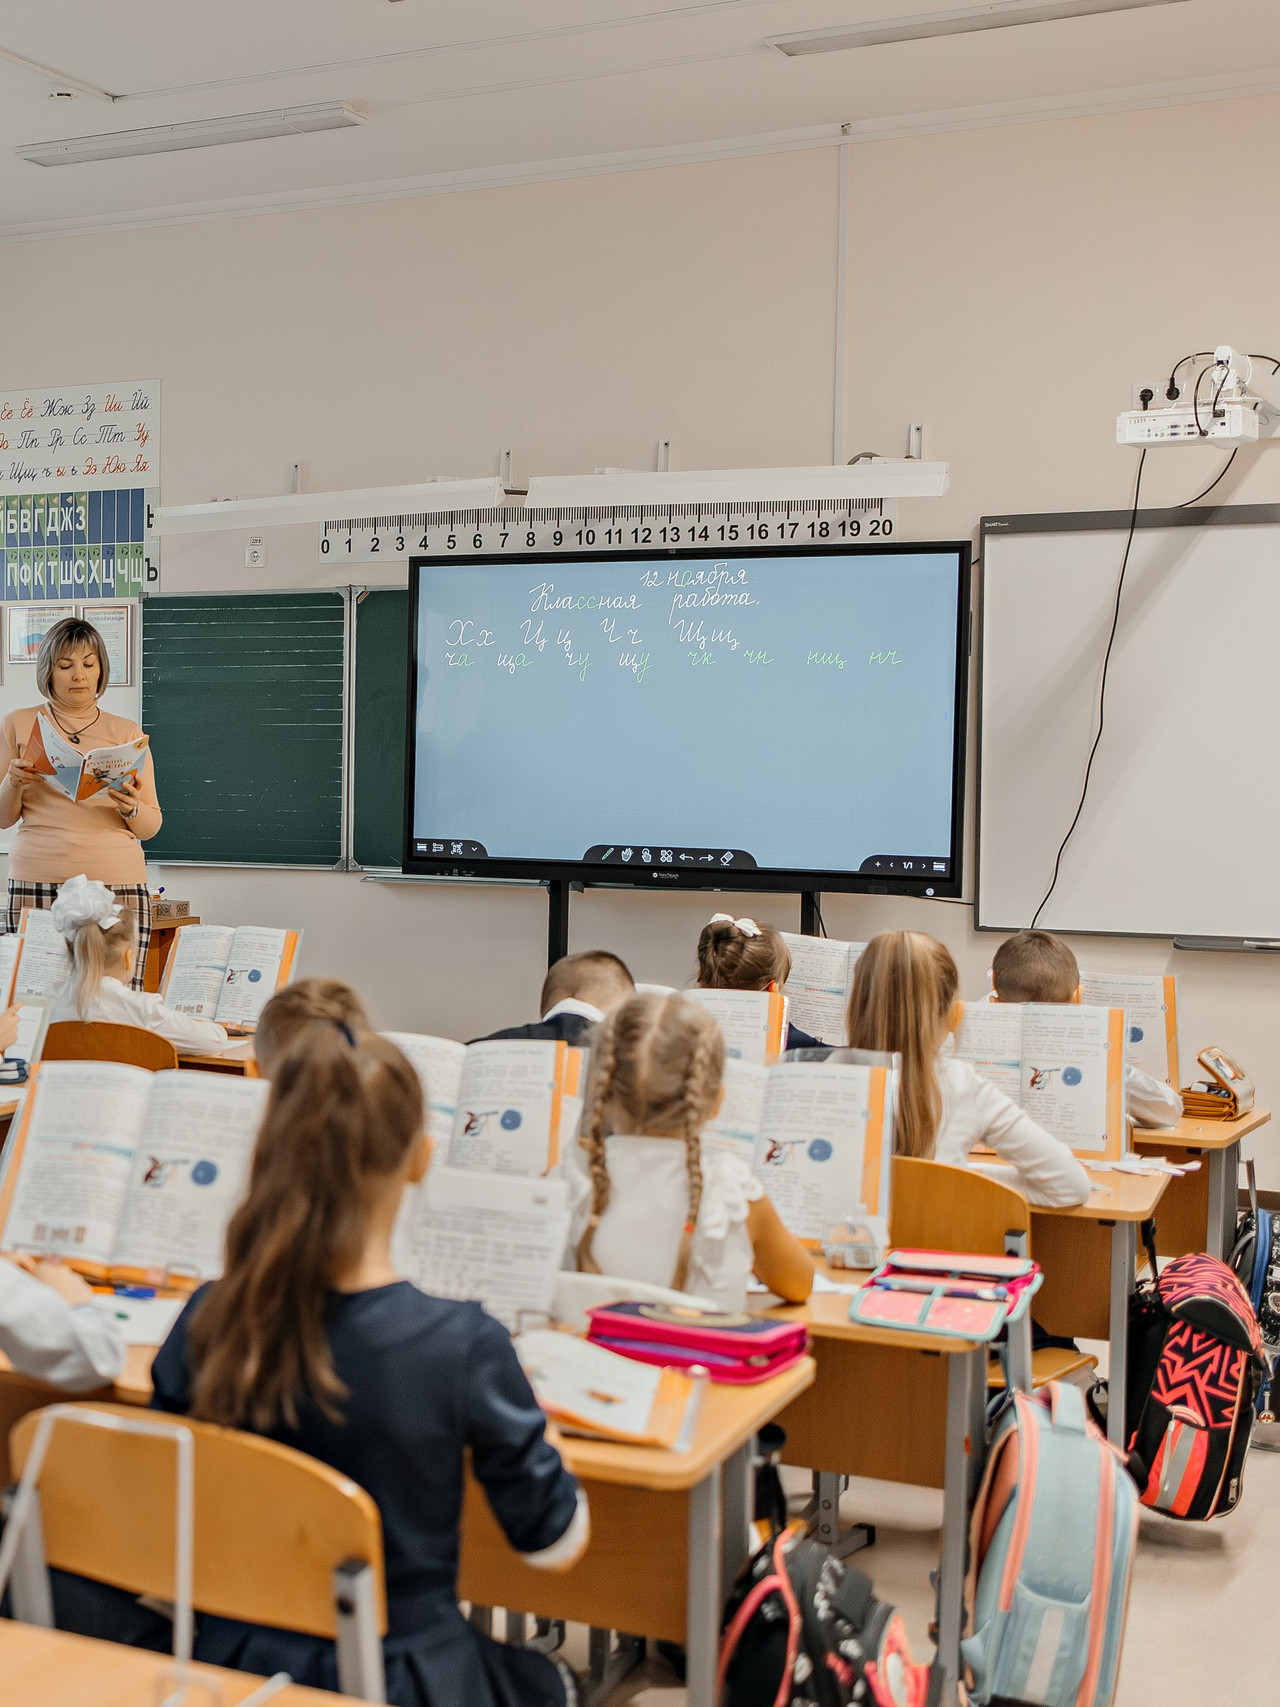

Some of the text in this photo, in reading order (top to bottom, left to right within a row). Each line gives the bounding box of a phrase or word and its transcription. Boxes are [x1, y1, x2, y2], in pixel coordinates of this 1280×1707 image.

[0, 402, 14, 420] Ее
[20, 398, 34, 418] Ёё
[40, 398, 74, 417] Жж
[82, 395, 96, 420] Зз
[104, 394, 122, 412] Ии
[132, 389, 150, 410] Йй
[17, 430, 40, 448] Пп
[48, 428, 65, 454] Рр
[73, 427, 88, 445] Сс
[98, 424, 126, 443] Тт
[134, 422, 150, 448] Уу
[9, 462, 38, 483] Щщ
[42, 467, 52, 478] ъ
[56, 466, 66, 476] ы
[70, 465, 77, 474] ь
[82, 457, 98, 474] Ээ
[102, 456, 126, 473] Юю
[130, 454, 150, 472] Яя
[320, 519, 893, 554] 0 1 2 3 4 5 6 7 8 9 10 11 12 13 14 15 16 17 18 19 20
[640, 570, 664, 587] 12
[528, 583, 642, 612] Классная
[444, 652, 475, 667] ча
[497, 652, 534, 674] ща
[565, 652, 592, 682] чу
[619, 652, 653, 683] щу
[687, 651, 716, 666] чк
[744, 649, 774, 665] чн
[902, 861, 913, 870] 1/1
